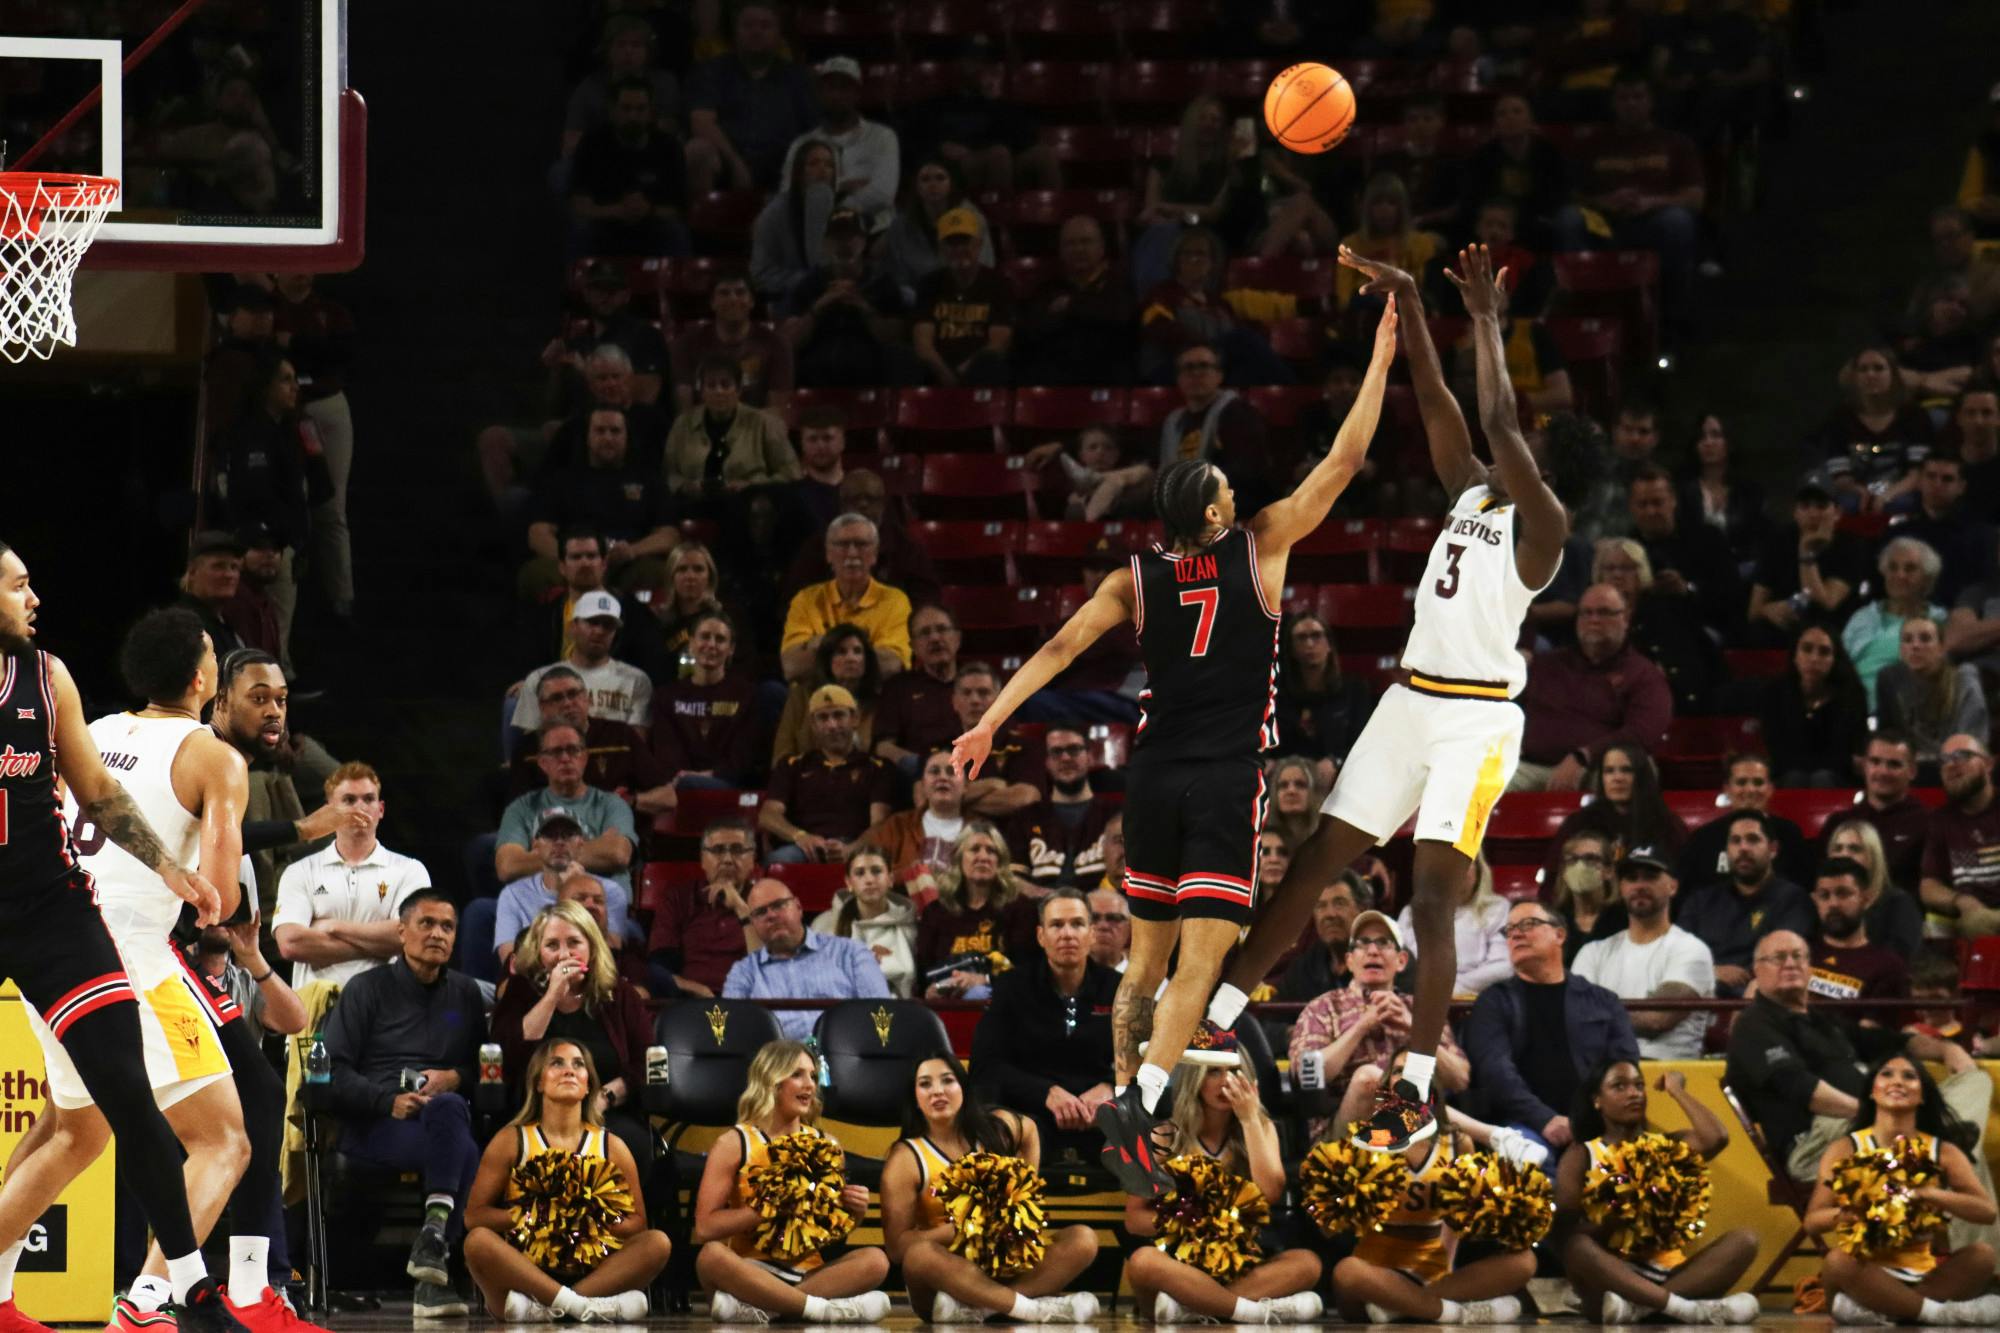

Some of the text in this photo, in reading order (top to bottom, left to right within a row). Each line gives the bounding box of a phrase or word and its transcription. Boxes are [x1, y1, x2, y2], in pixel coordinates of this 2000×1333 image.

[1173, 554, 1218, 583] UZAN
[1435, 543, 1467, 599] 3
[1179, 586, 1219, 657] 7
